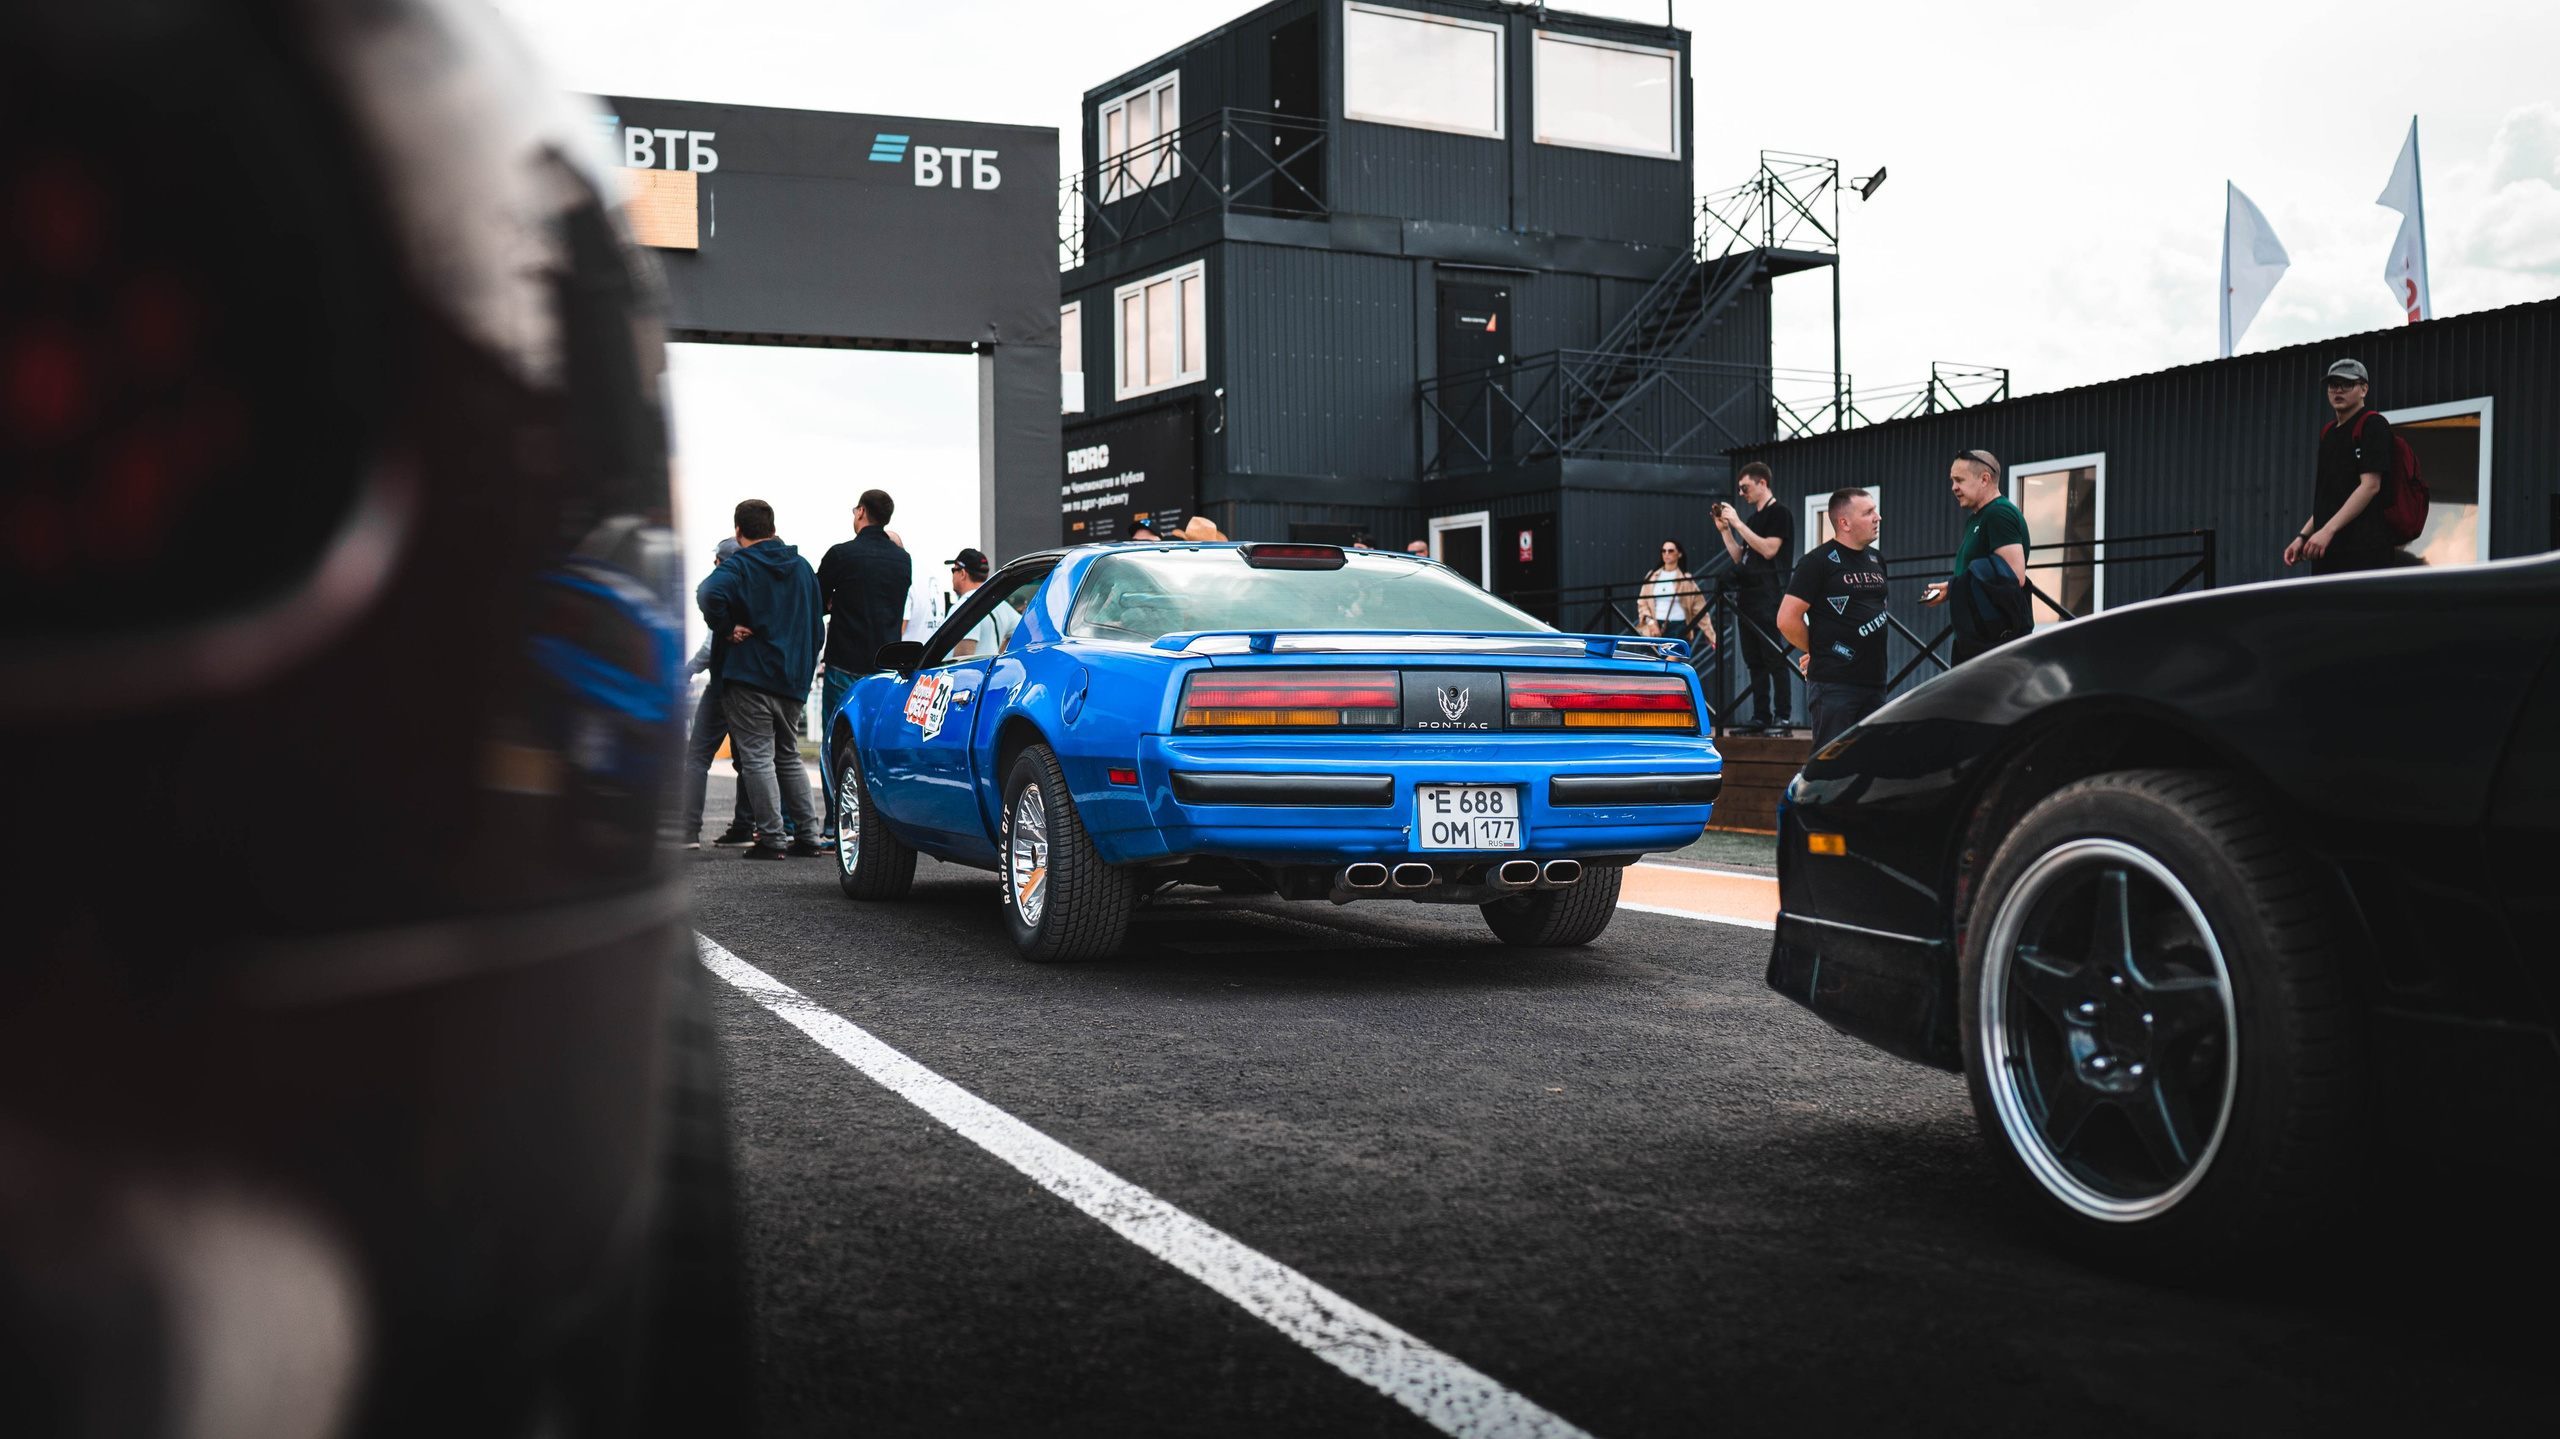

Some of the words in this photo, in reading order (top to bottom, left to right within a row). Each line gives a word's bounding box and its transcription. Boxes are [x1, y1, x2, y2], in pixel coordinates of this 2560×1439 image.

[624, 126, 719, 173] ВТБ
[914, 145, 1001, 191] ВТБ
[1067, 444, 1110, 474] RDRC
[1843, 572, 1885, 584] GUESS
[932, 683, 949, 711] 21
[1418, 721, 1488, 729] PONTIAC
[1459, 790, 1503, 814] 688
[1001, 804, 1011, 834] G/T
[1480, 820, 1515, 839] 177
[1001, 840, 1011, 905] RADIAL
